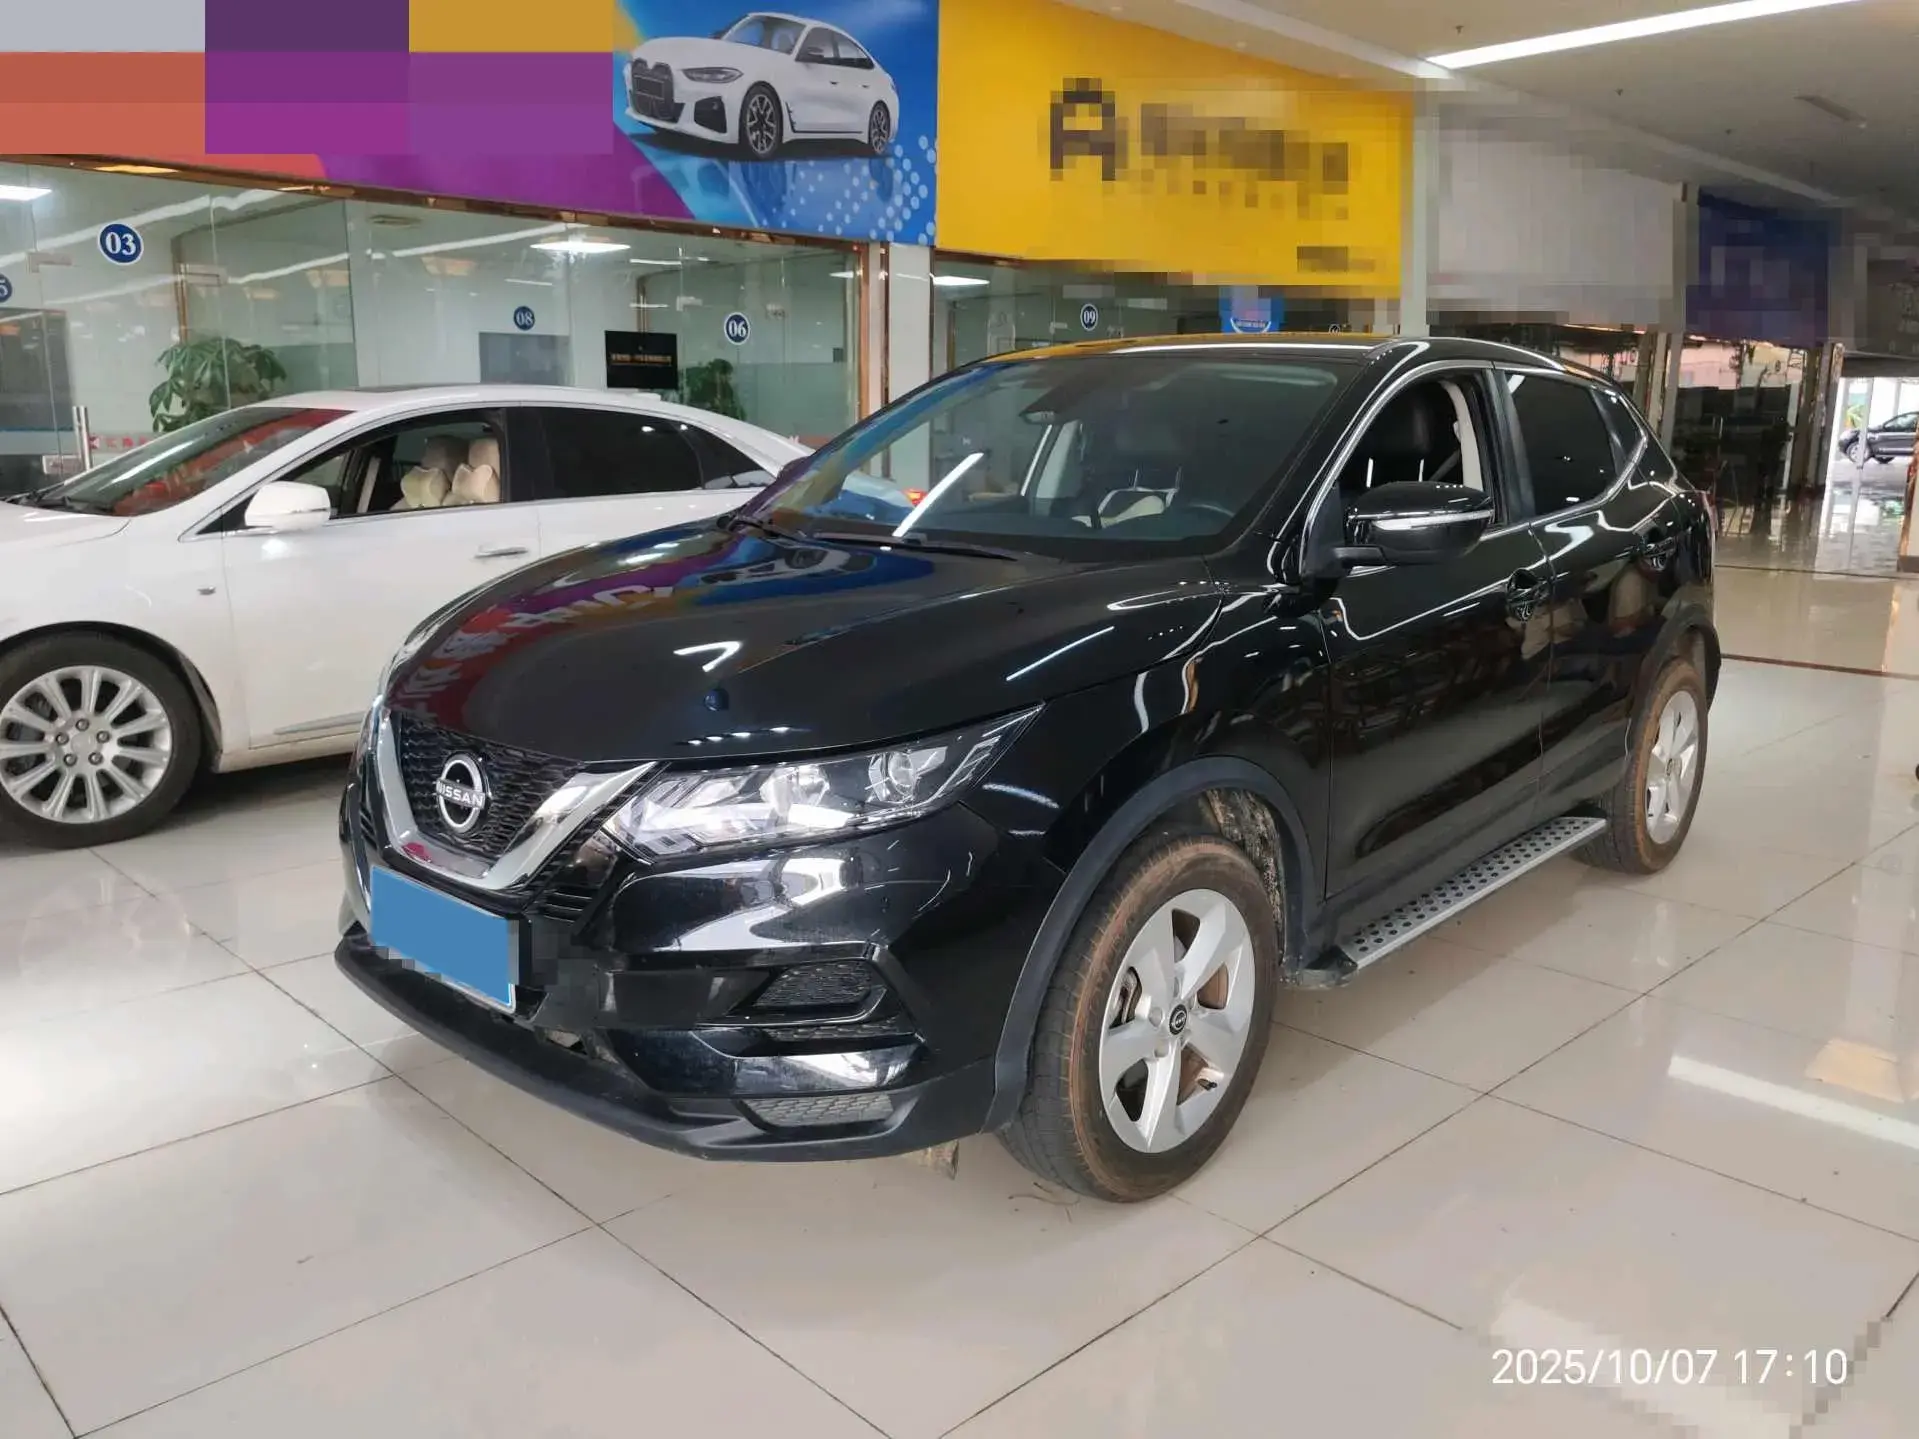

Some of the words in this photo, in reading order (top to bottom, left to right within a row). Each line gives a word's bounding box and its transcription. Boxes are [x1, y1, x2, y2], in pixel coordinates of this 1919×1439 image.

[105, 231, 137, 256] 03
[515, 310, 534, 327] 08
[1083, 310, 1096, 324] 09
[727, 319, 747, 338] 06
[436, 780, 484, 808] NISSAN
